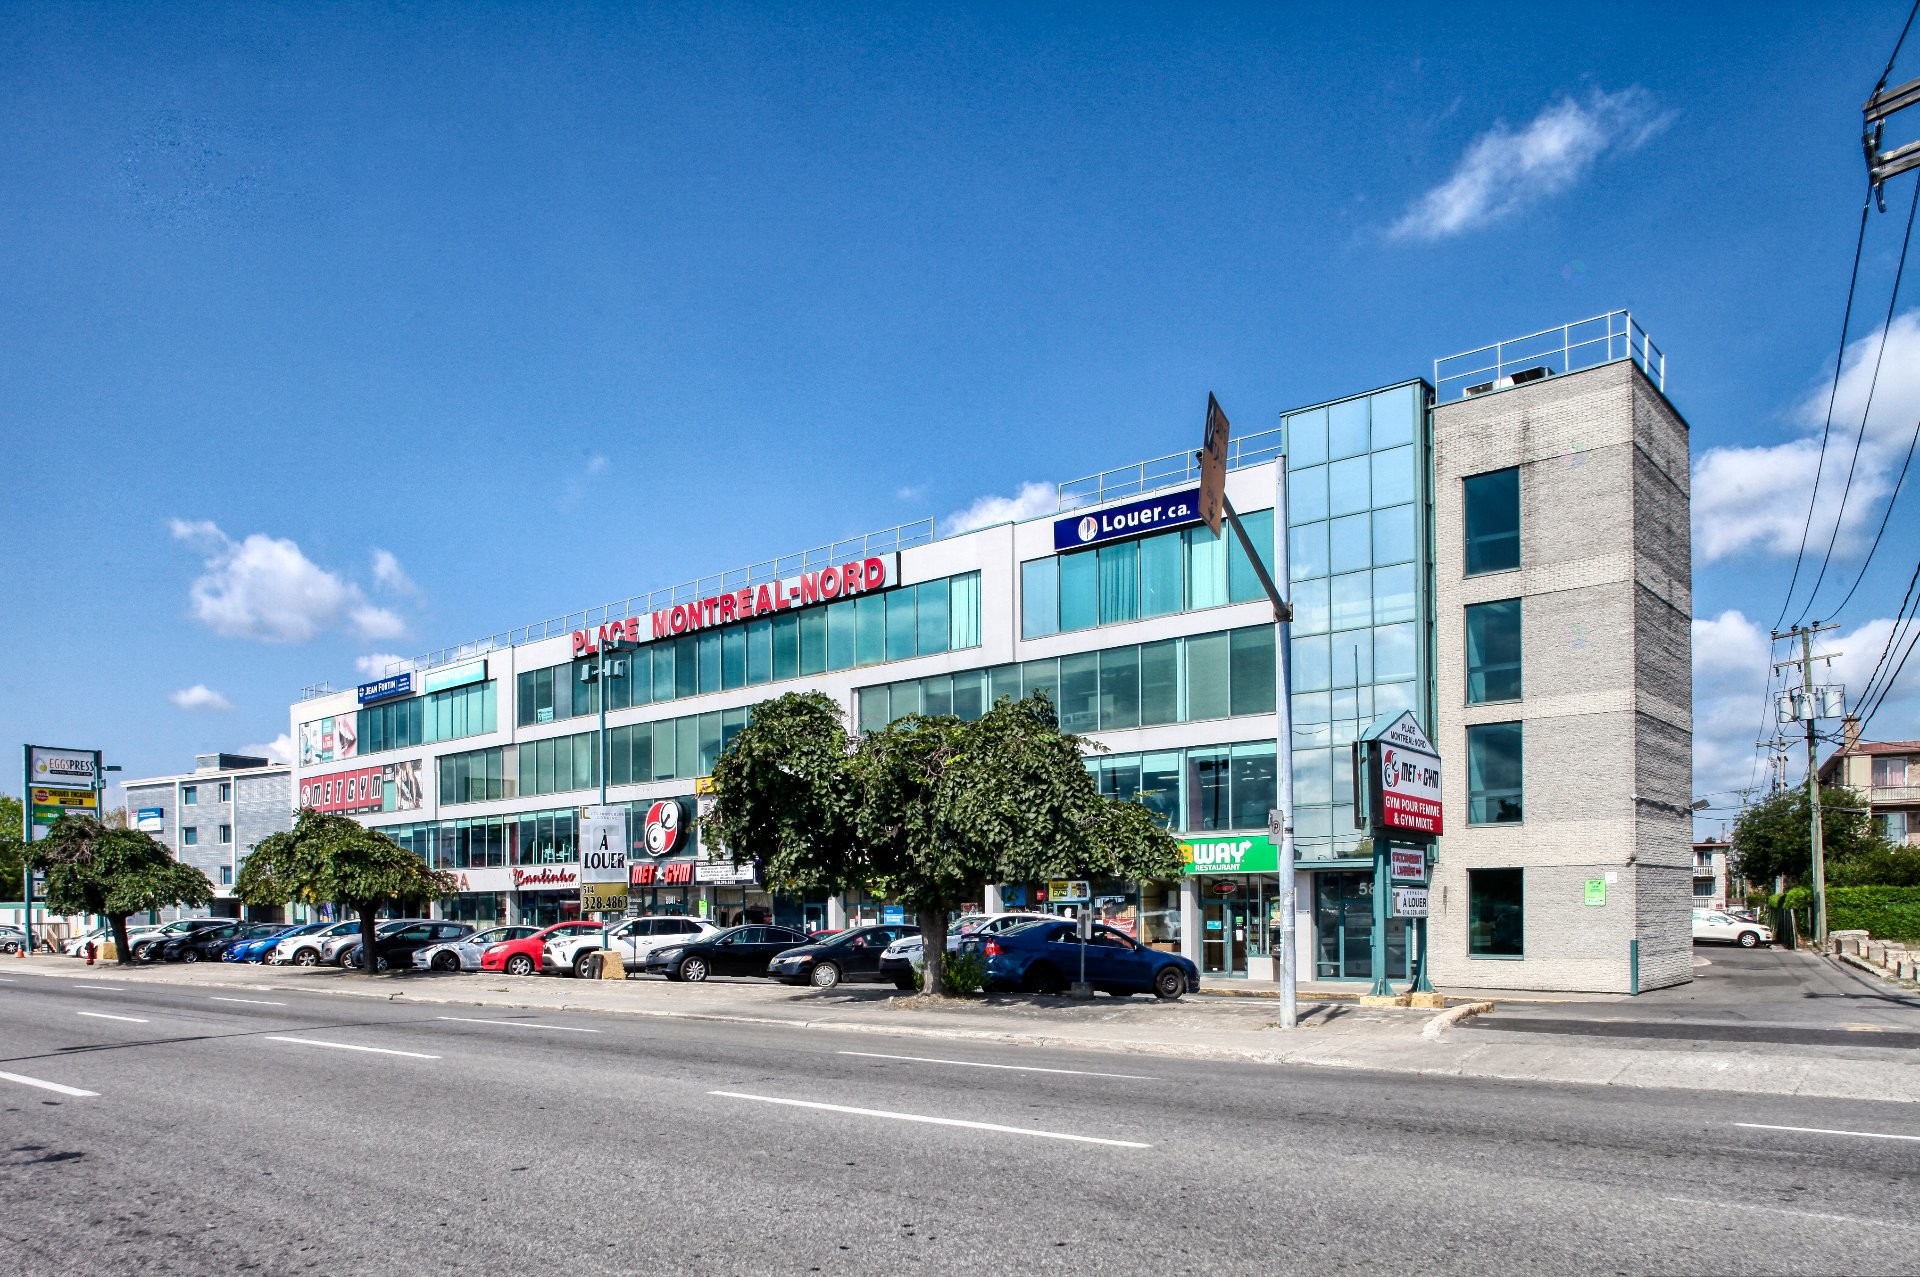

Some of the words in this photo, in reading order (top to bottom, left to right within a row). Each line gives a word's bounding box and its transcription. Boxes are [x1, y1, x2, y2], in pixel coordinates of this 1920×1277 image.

[572, 617, 639, 657] PLACE
[652, 557, 886, 639] MONTREAL-NORD
[365, 684, 378, 696] JEAN
[379, 680, 396, 692] FORTIN
[1401, 723, 1416, 735] PLACE
[49, 758, 95, 771] EGGSPRESS
[1400, 761, 1417, 784] MET
[1423, 767, 1439, 789] GYM
[1385, 795, 1401, 811] GYM
[1401, 799, 1419, 813] POUR
[1419, 802, 1440, 818] FEMME
[1393, 812, 1400, 825] &
[1400, 813, 1415, 827] GYM
[1415, 816, 1434, 831] MIXTE
[599, 828, 609, 851] À
[584, 852, 625, 869] LOUER
[1195, 863, 1241, 872] RESTAURANT
[512, 867, 577, 887] Cantinho
[631, 865, 656, 886] MET
[663, 863, 691, 884] GYM
[583, 885, 595, 895] 514
[583, 896, 628, 910] 328.4863
[1408, 897, 1427, 908] LOUER
